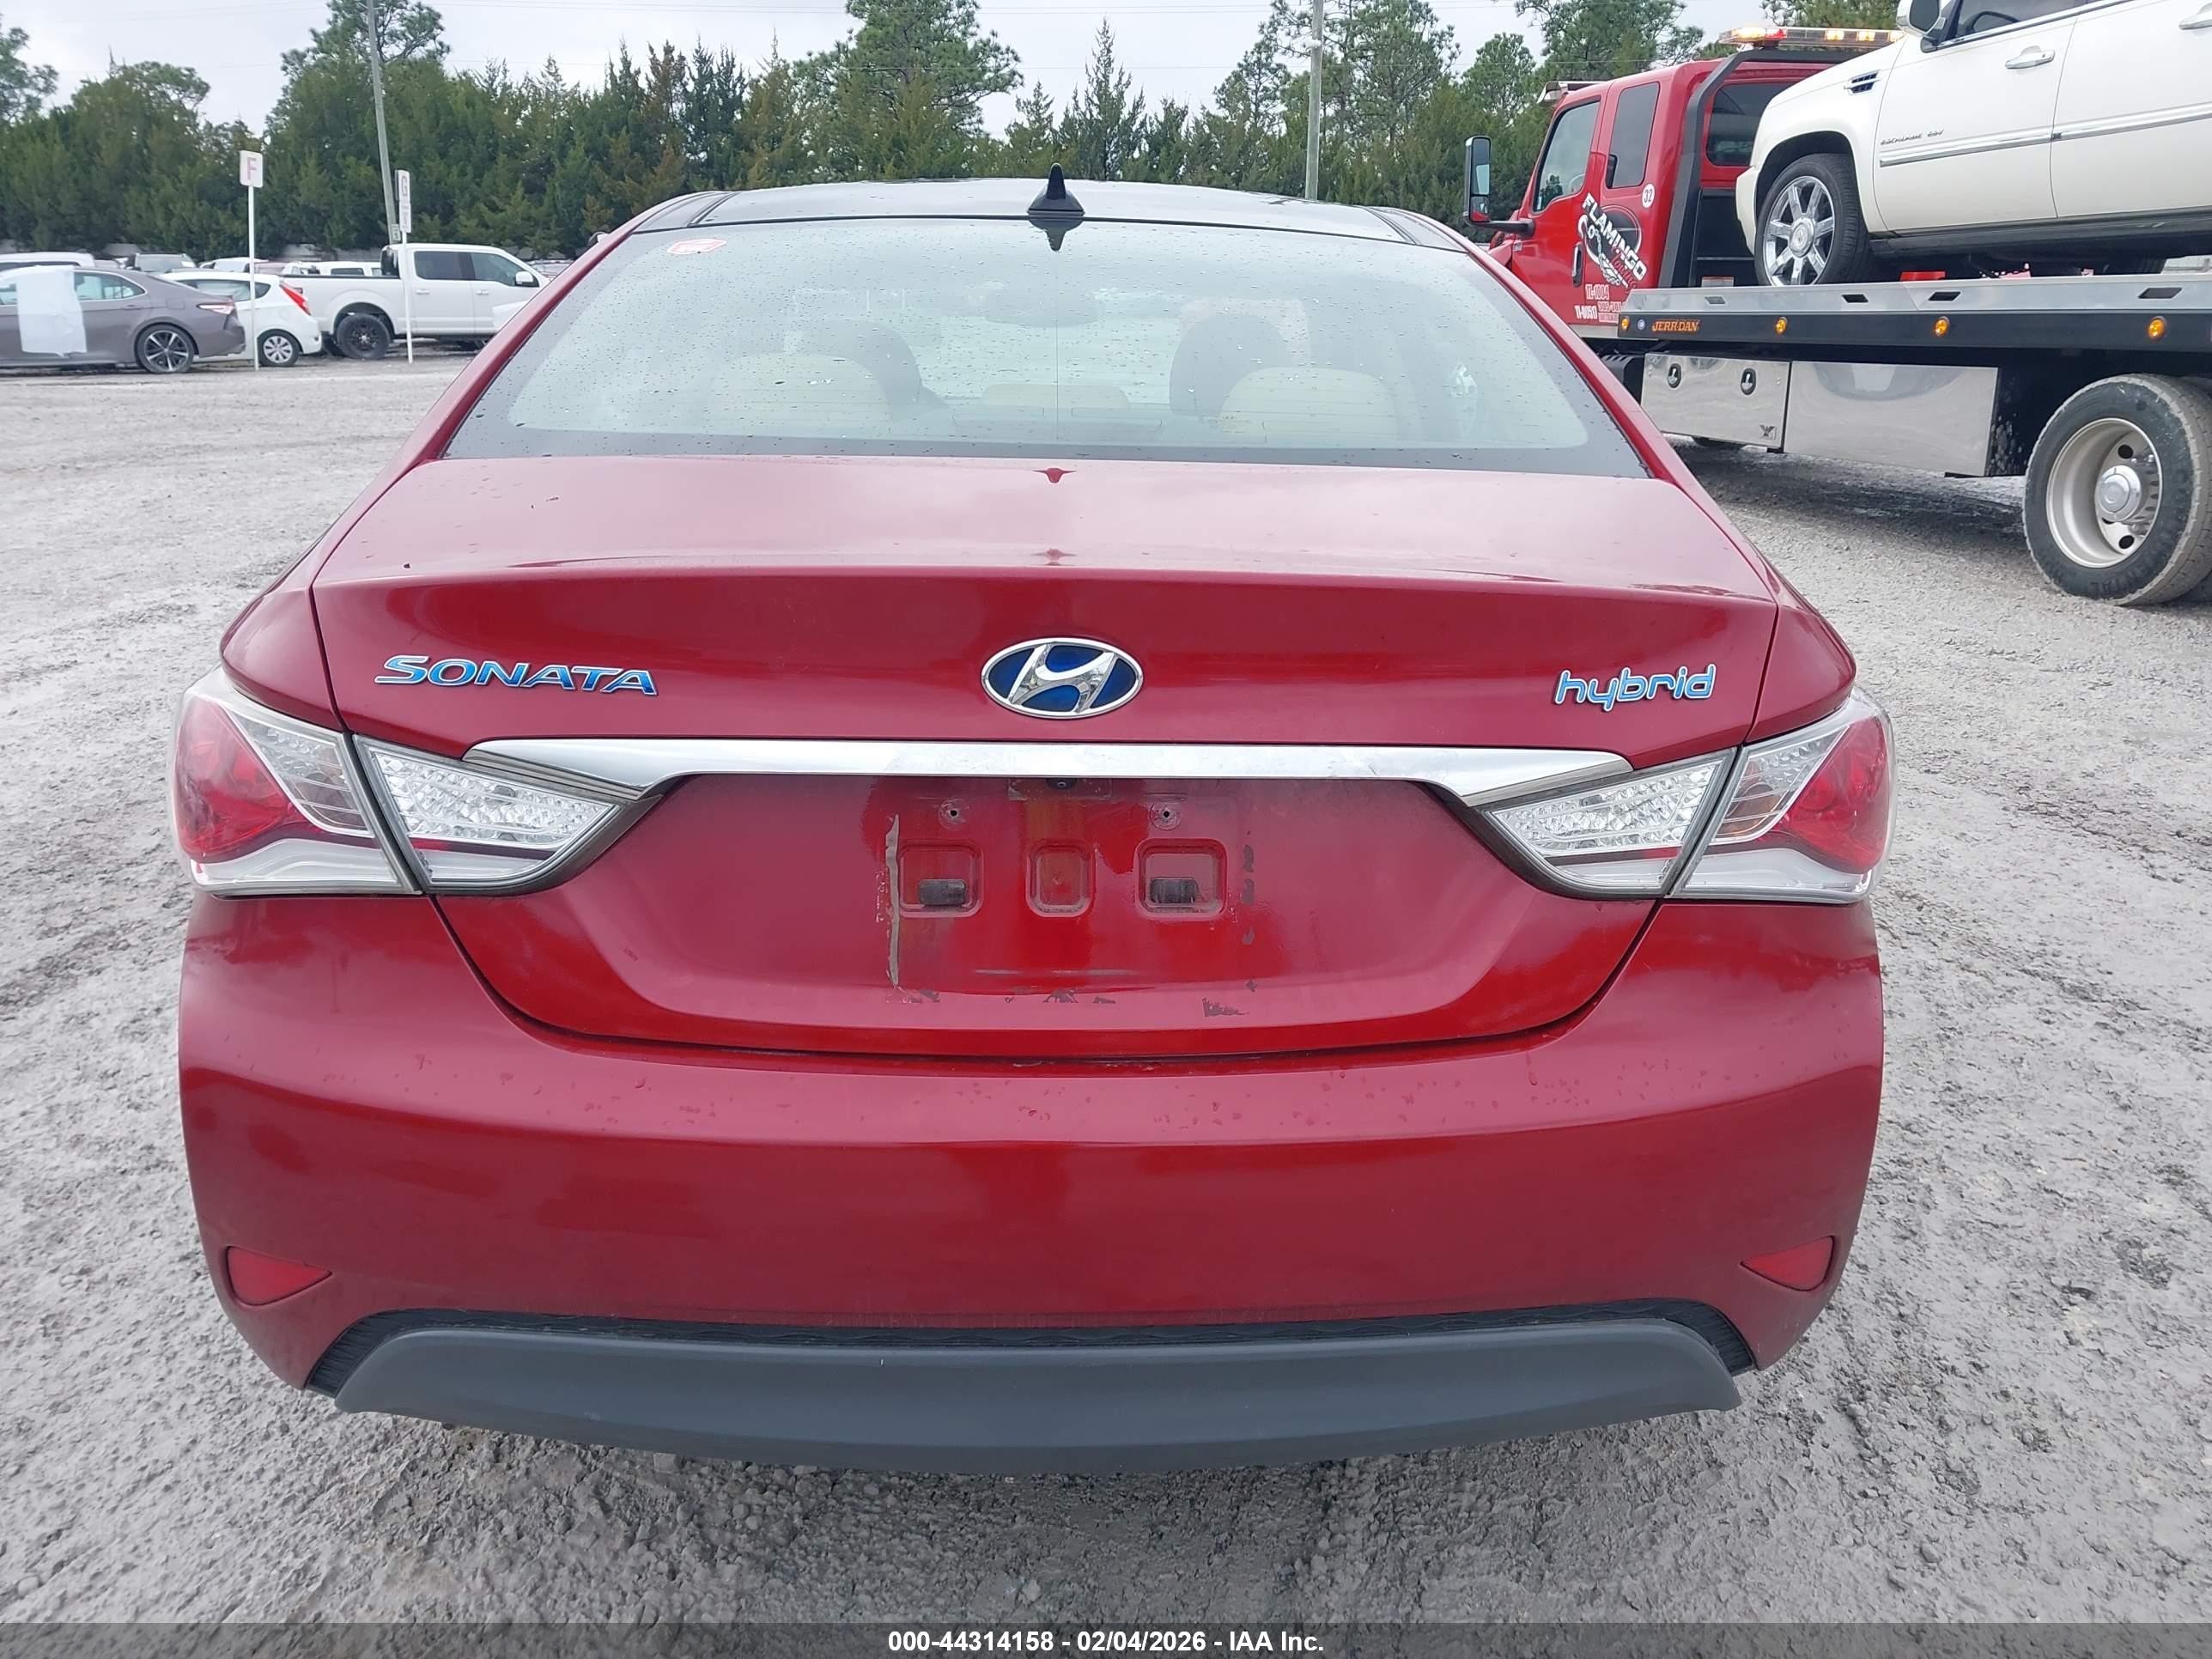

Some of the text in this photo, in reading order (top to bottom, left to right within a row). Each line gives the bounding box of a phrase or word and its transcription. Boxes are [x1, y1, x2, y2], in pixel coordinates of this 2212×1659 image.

[246, 157, 257, 180] F
[1582, 192, 1647, 281] FLAMINGO
[374, 654, 659, 696] SONATA
[1554, 664, 1716, 711] hybrid
